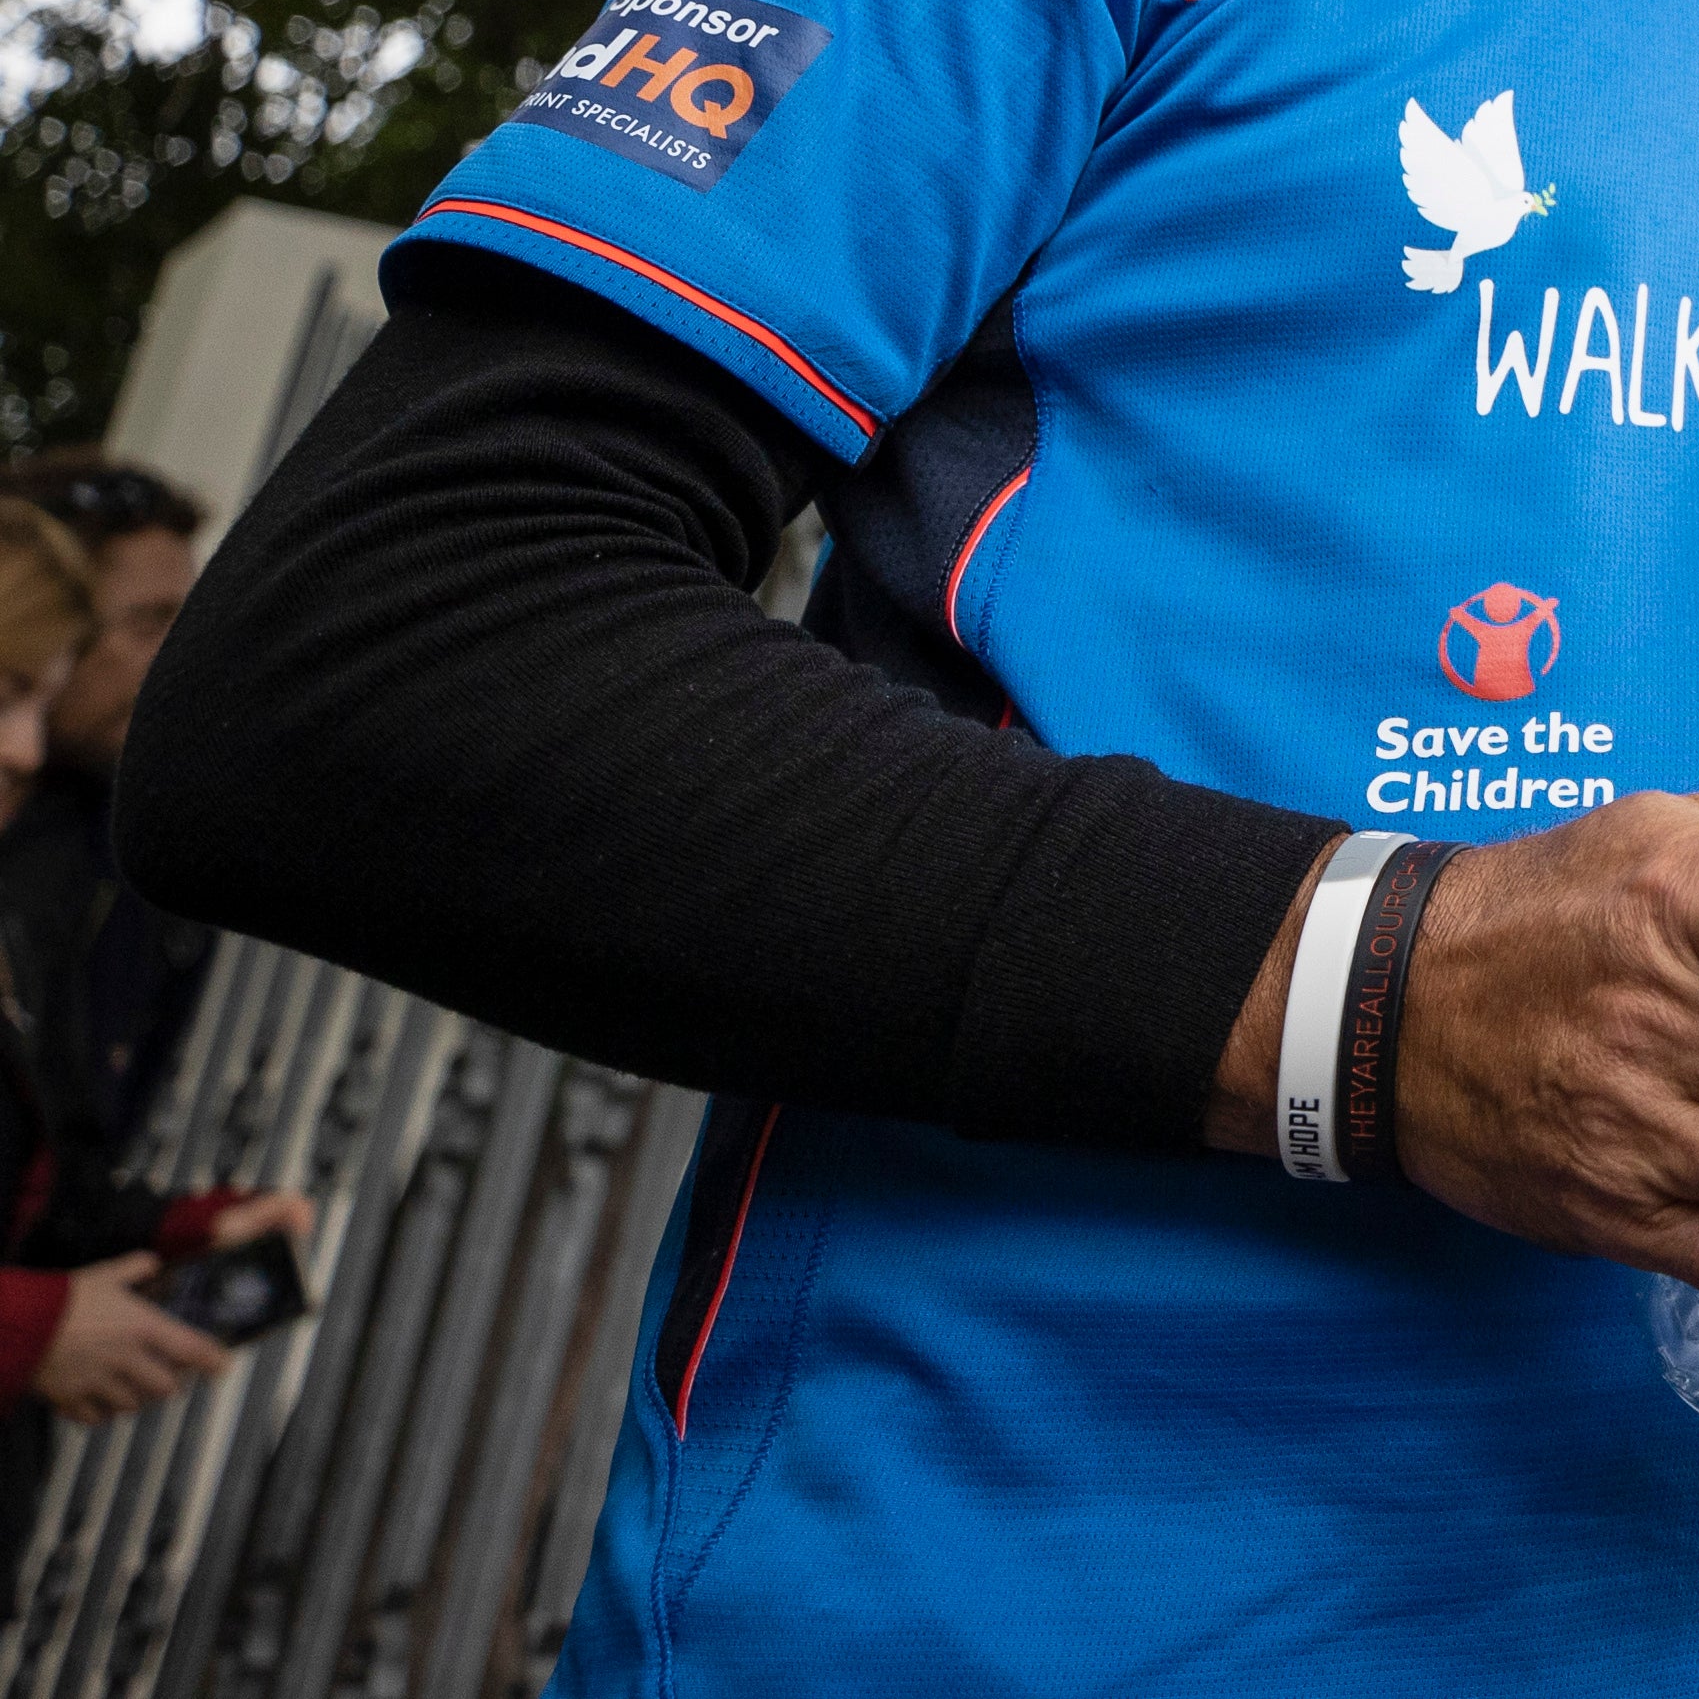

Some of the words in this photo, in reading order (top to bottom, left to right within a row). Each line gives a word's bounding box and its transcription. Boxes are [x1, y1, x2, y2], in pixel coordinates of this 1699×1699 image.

[544, 28, 754, 138] dHQ
[571, 99, 712, 170] SPECIALISTS
[1376, 717, 1509, 760] Save
[1522, 712, 1613, 754] the
[1366, 767, 1614, 813] Children
[1289, 1097, 1320, 1157] HOPE
